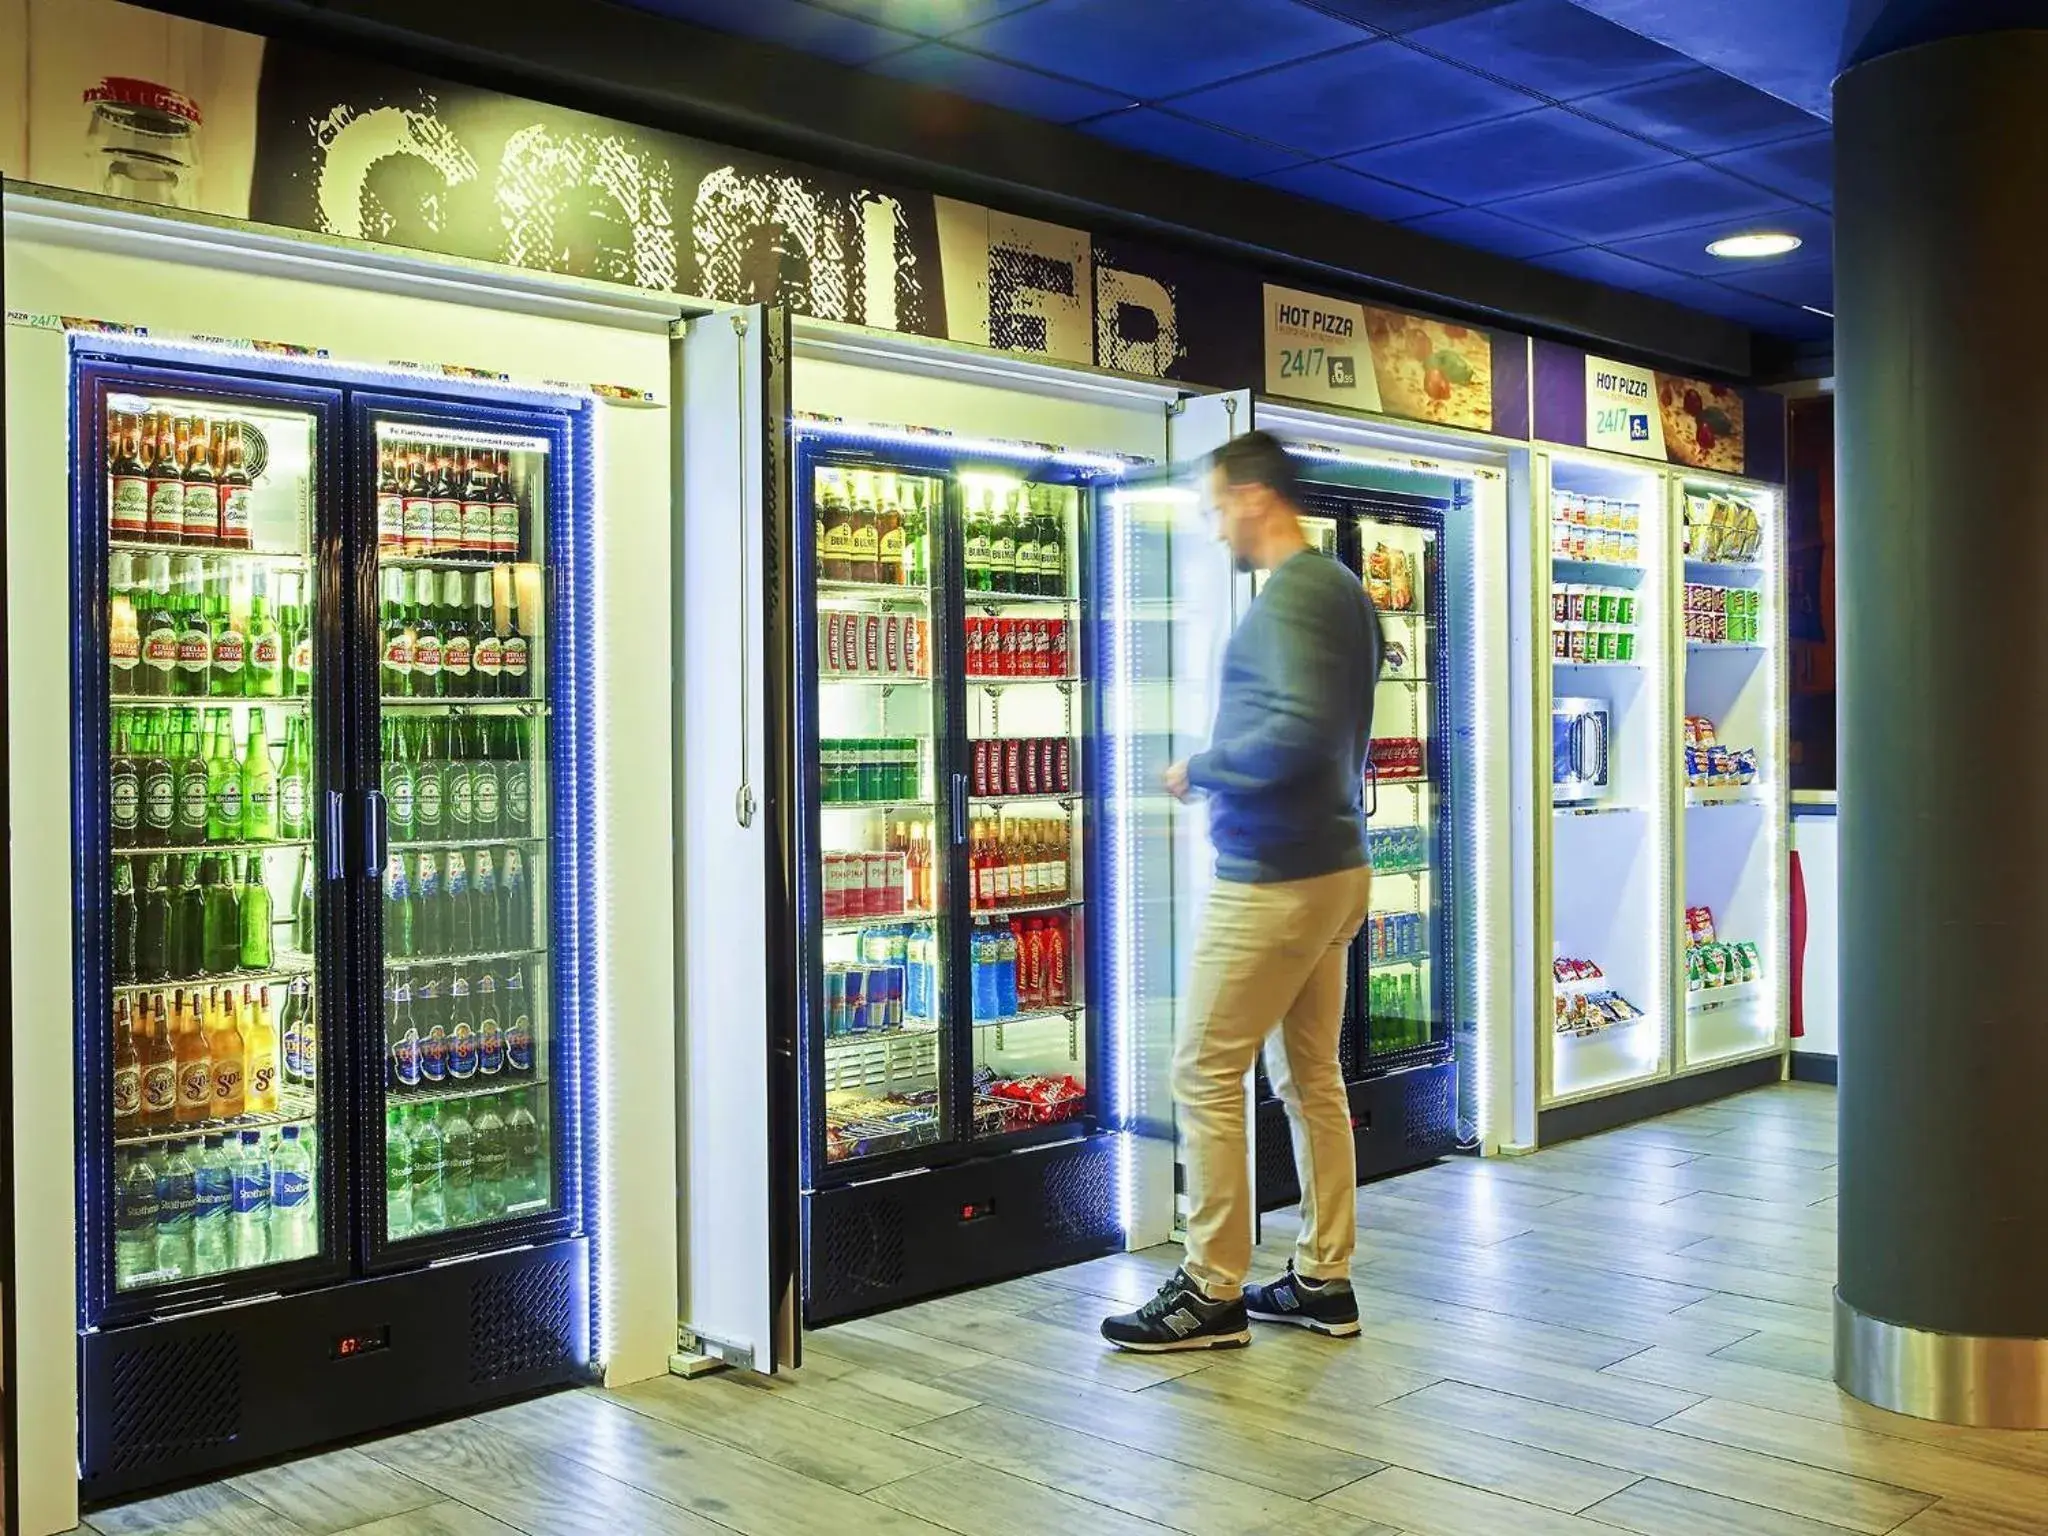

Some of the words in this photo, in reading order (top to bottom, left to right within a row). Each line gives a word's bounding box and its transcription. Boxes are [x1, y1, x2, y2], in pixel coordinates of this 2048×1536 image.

[1280, 304, 1310, 327] HOT
[1312, 312, 1354, 338] PIZZA
[1281, 347, 1324, 379] 24/7
[1597, 372, 1618, 391] HOT
[1618, 378, 1648, 398] PIZZA
[1597, 408, 1628, 435] 24/7
